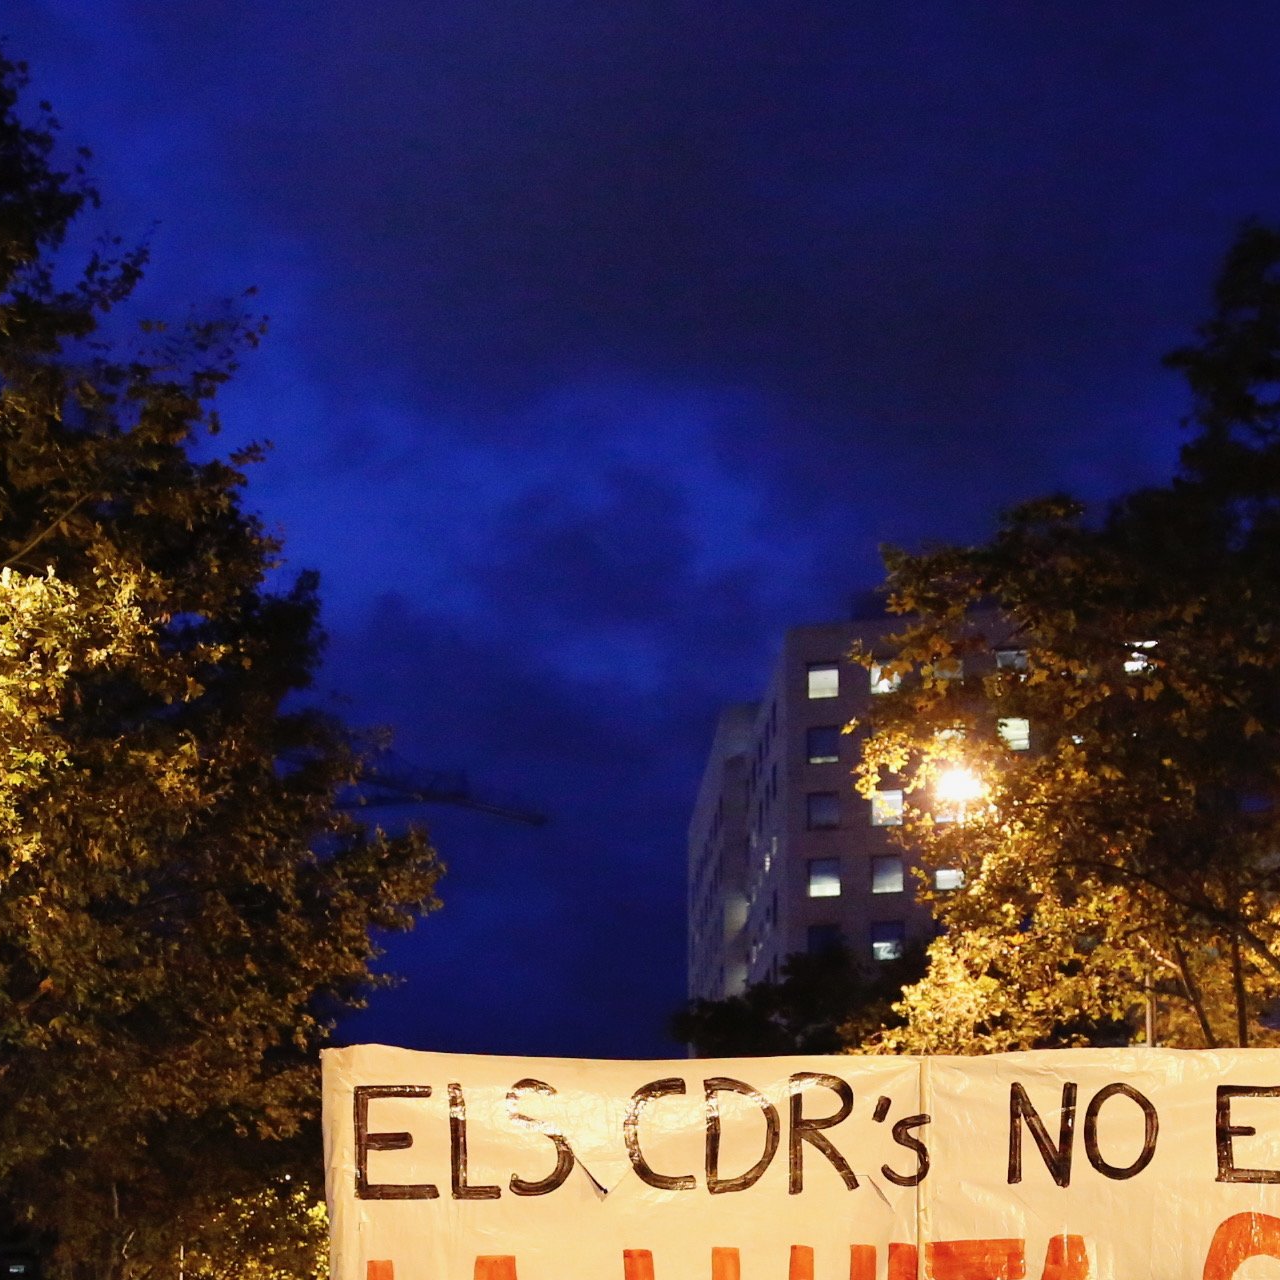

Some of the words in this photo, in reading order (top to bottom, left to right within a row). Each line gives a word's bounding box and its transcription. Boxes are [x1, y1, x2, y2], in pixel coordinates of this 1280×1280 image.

[354, 1078, 575, 1200] ELS
[623, 1072, 931, 1195] CDR's
[1007, 1082, 1160, 1188] NO
